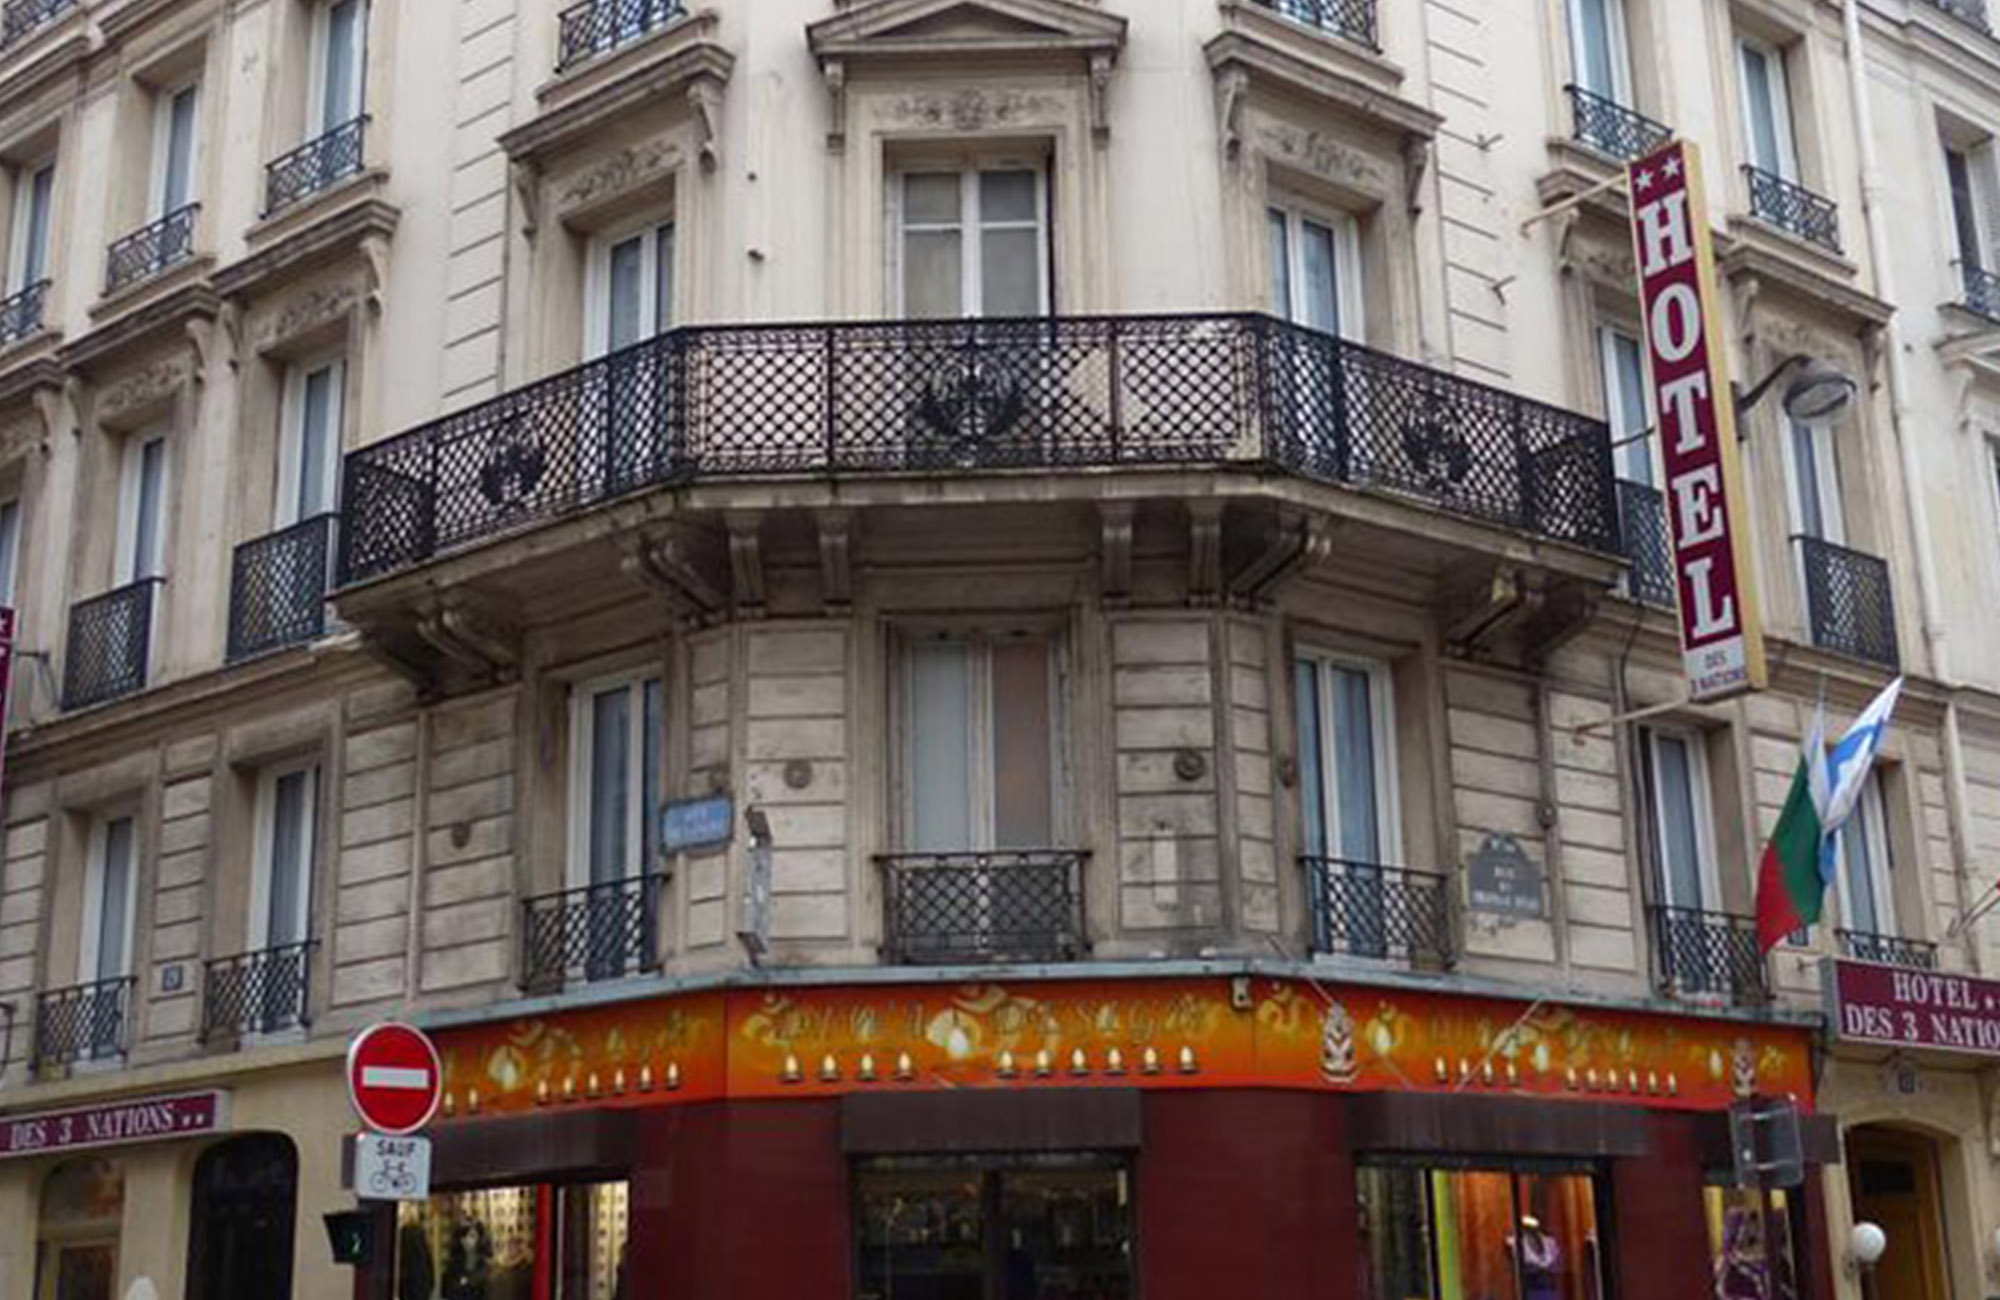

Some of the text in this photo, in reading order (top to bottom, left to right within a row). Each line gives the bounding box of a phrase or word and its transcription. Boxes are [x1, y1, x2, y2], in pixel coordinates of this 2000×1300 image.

[1636, 186, 1736, 640] HOTEL
[1893, 971, 1977, 1010] HOTEL
[1844, 1003, 1894, 1037] DES
[1902, 1010, 1919, 1040] 3
[9, 1103, 174, 1149] DES 3 NATIONS
[376, 1139, 416, 1157] SAUF
